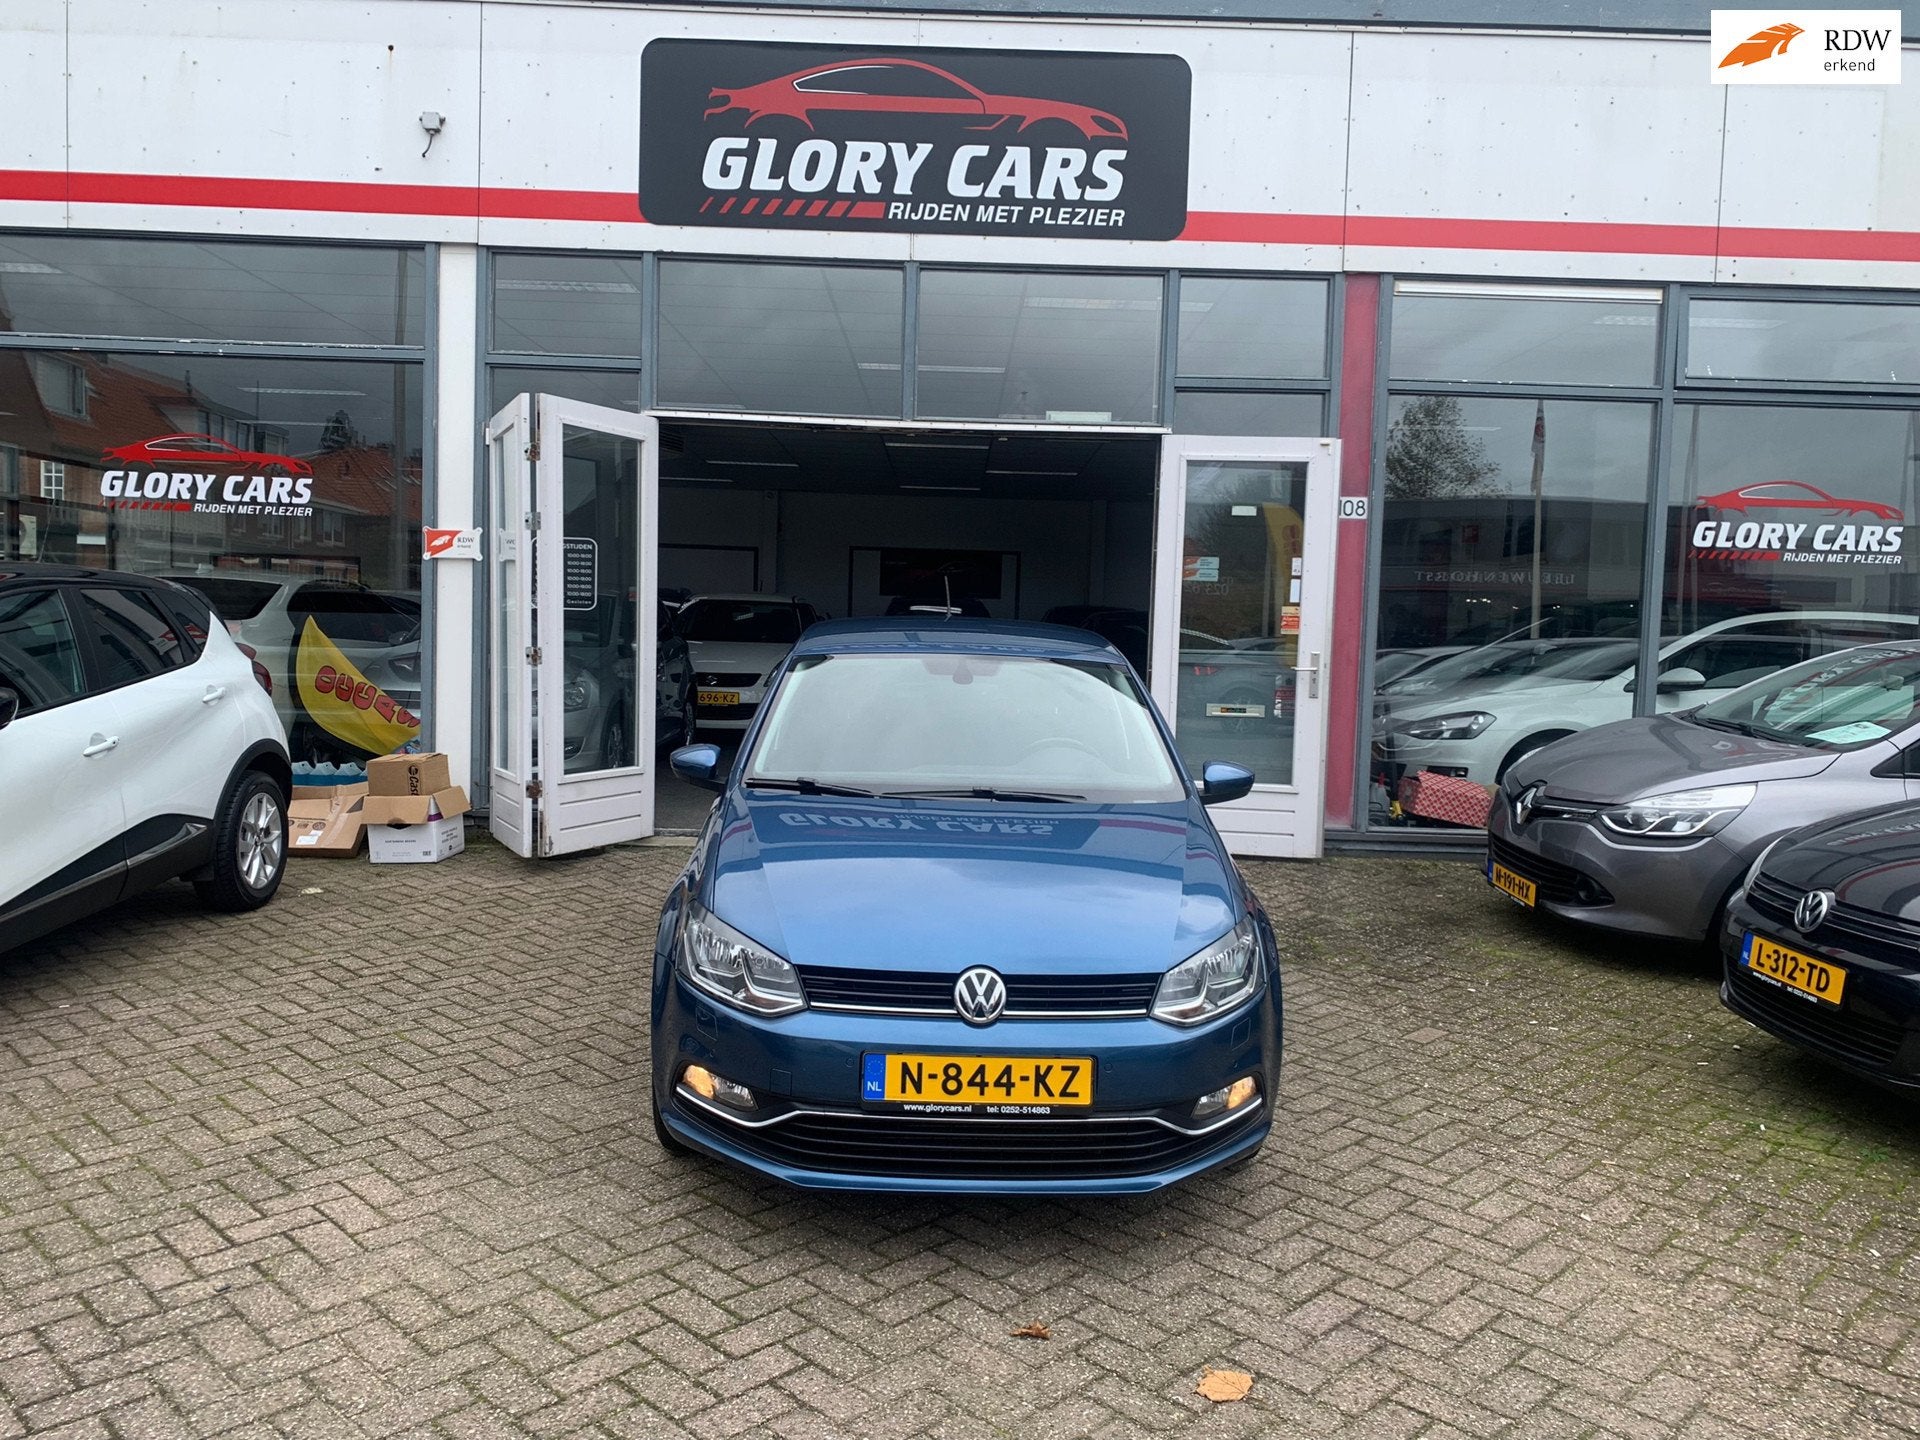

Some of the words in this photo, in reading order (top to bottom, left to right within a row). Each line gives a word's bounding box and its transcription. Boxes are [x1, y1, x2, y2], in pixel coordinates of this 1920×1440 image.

[702, 137, 934, 195] GLORY
[946, 144, 1128, 202] CARS
[888, 201, 971, 222] RIJDEN
[975, 205, 1023, 223] MET
[1029, 206, 1126, 227] PLEZIER
[100, 470, 216, 501] GLORY
[222, 475, 313, 504] CARS
[193, 503, 235, 514] RIJDEN
[237, 505, 262, 515] MET
[265, 506, 313, 517] PLEZIER
[457, 536, 475, 544] RDW
[1692, 521, 1808, 550] GLORY
[1812, 524, 1905, 552] CARS
[1783, 552, 1827, 563] RIJDEN
[1826, 554, 1852, 564] MET
[1853, 555, 1903, 565] PLEZIER
[1756, 942, 1831, 993] L-312-TD
[867, 1080, 882, 1092] NL
[900, 1061, 1081, 1098] N-844-KZ
[903, 1104, 972, 1113] www.glorycars.nl
[1000, 1105, 1051, 1114] 0252-514863
